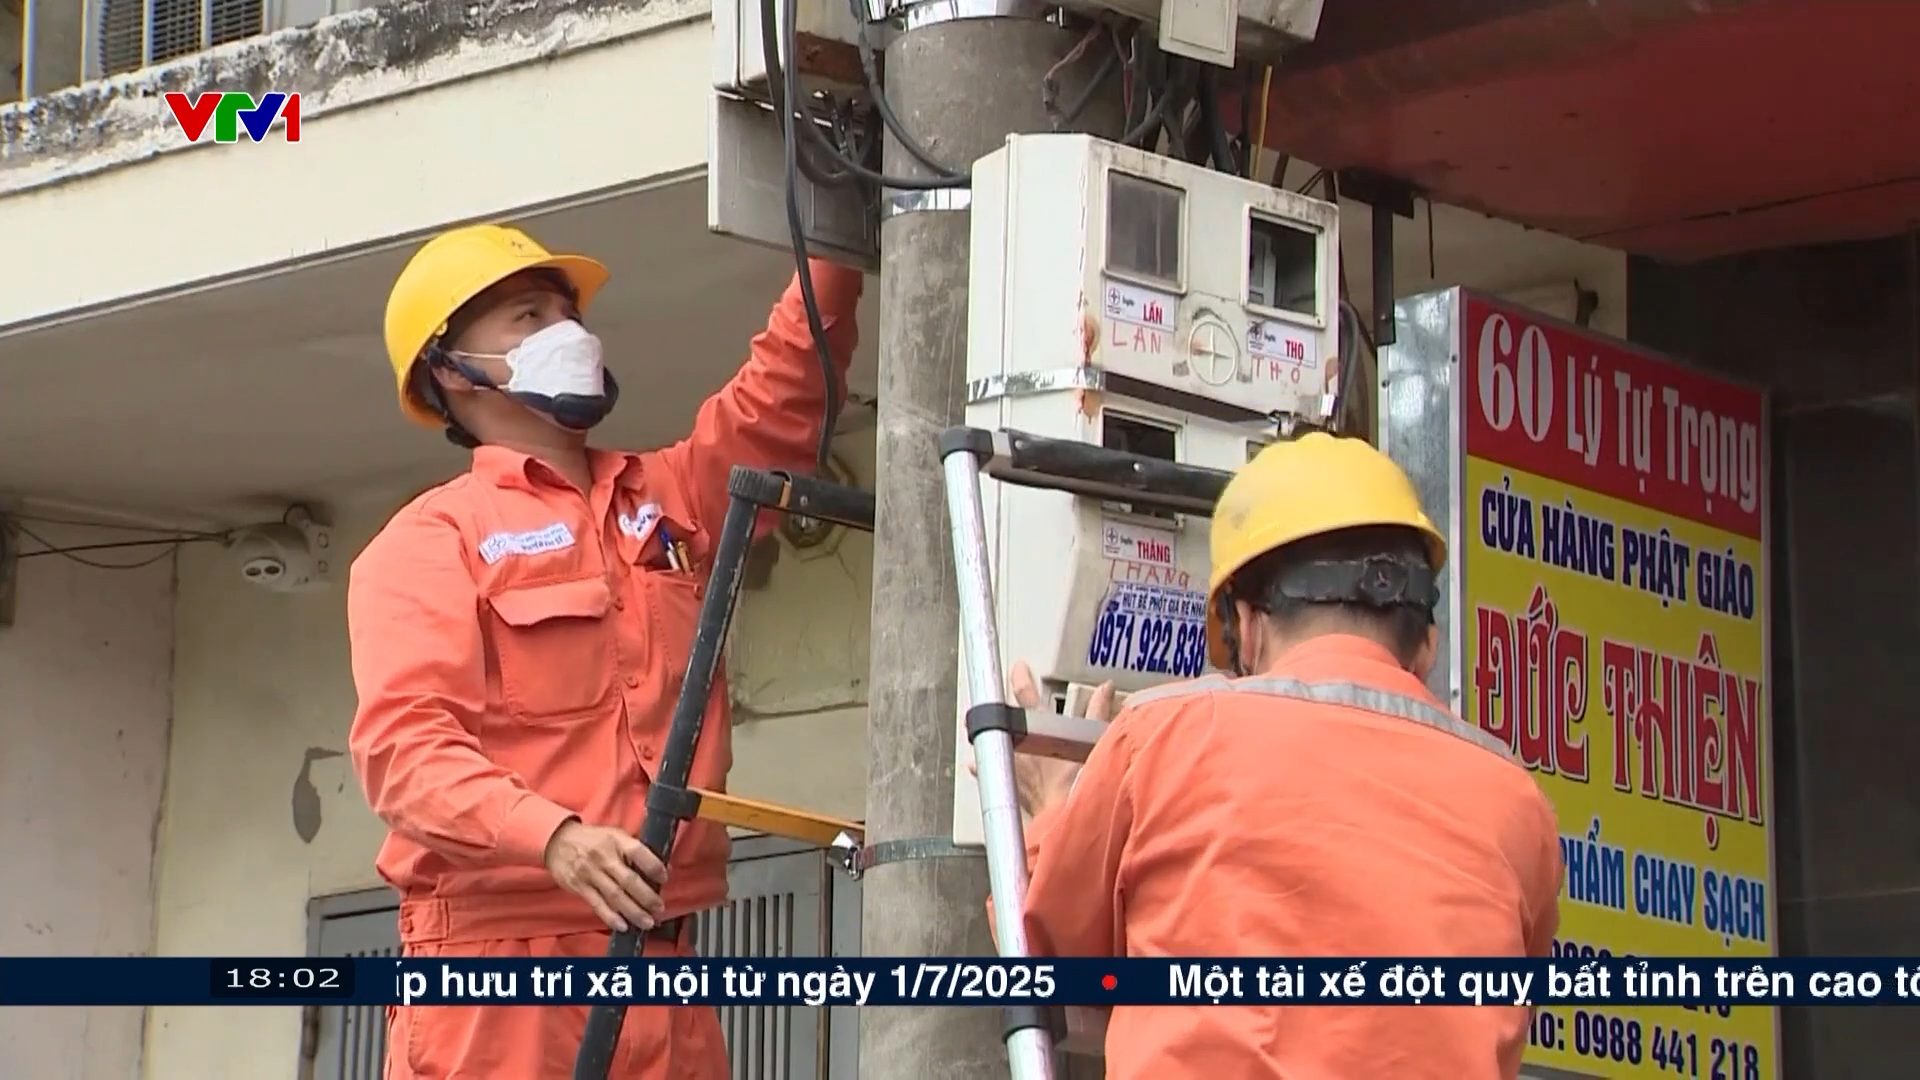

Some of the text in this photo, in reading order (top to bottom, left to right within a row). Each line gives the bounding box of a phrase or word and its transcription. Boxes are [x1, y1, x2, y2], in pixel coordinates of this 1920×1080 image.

[1478, 313, 1757, 514] 60 Lý Tự Trọng
[1481, 476, 1755, 621] CỬA HÀNG PHẬT GIÁO
[1475, 584, 1763, 849] ĐỨC THIỆN
[1634, 854, 1696, 925] CHAY
[1703, 870, 1766, 947] SẠCH
[1575, 1011, 1642, 1065] 0988
[1652, 1025, 1698, 1077] 441
[1711, 1038, 1759, 1080] 218
